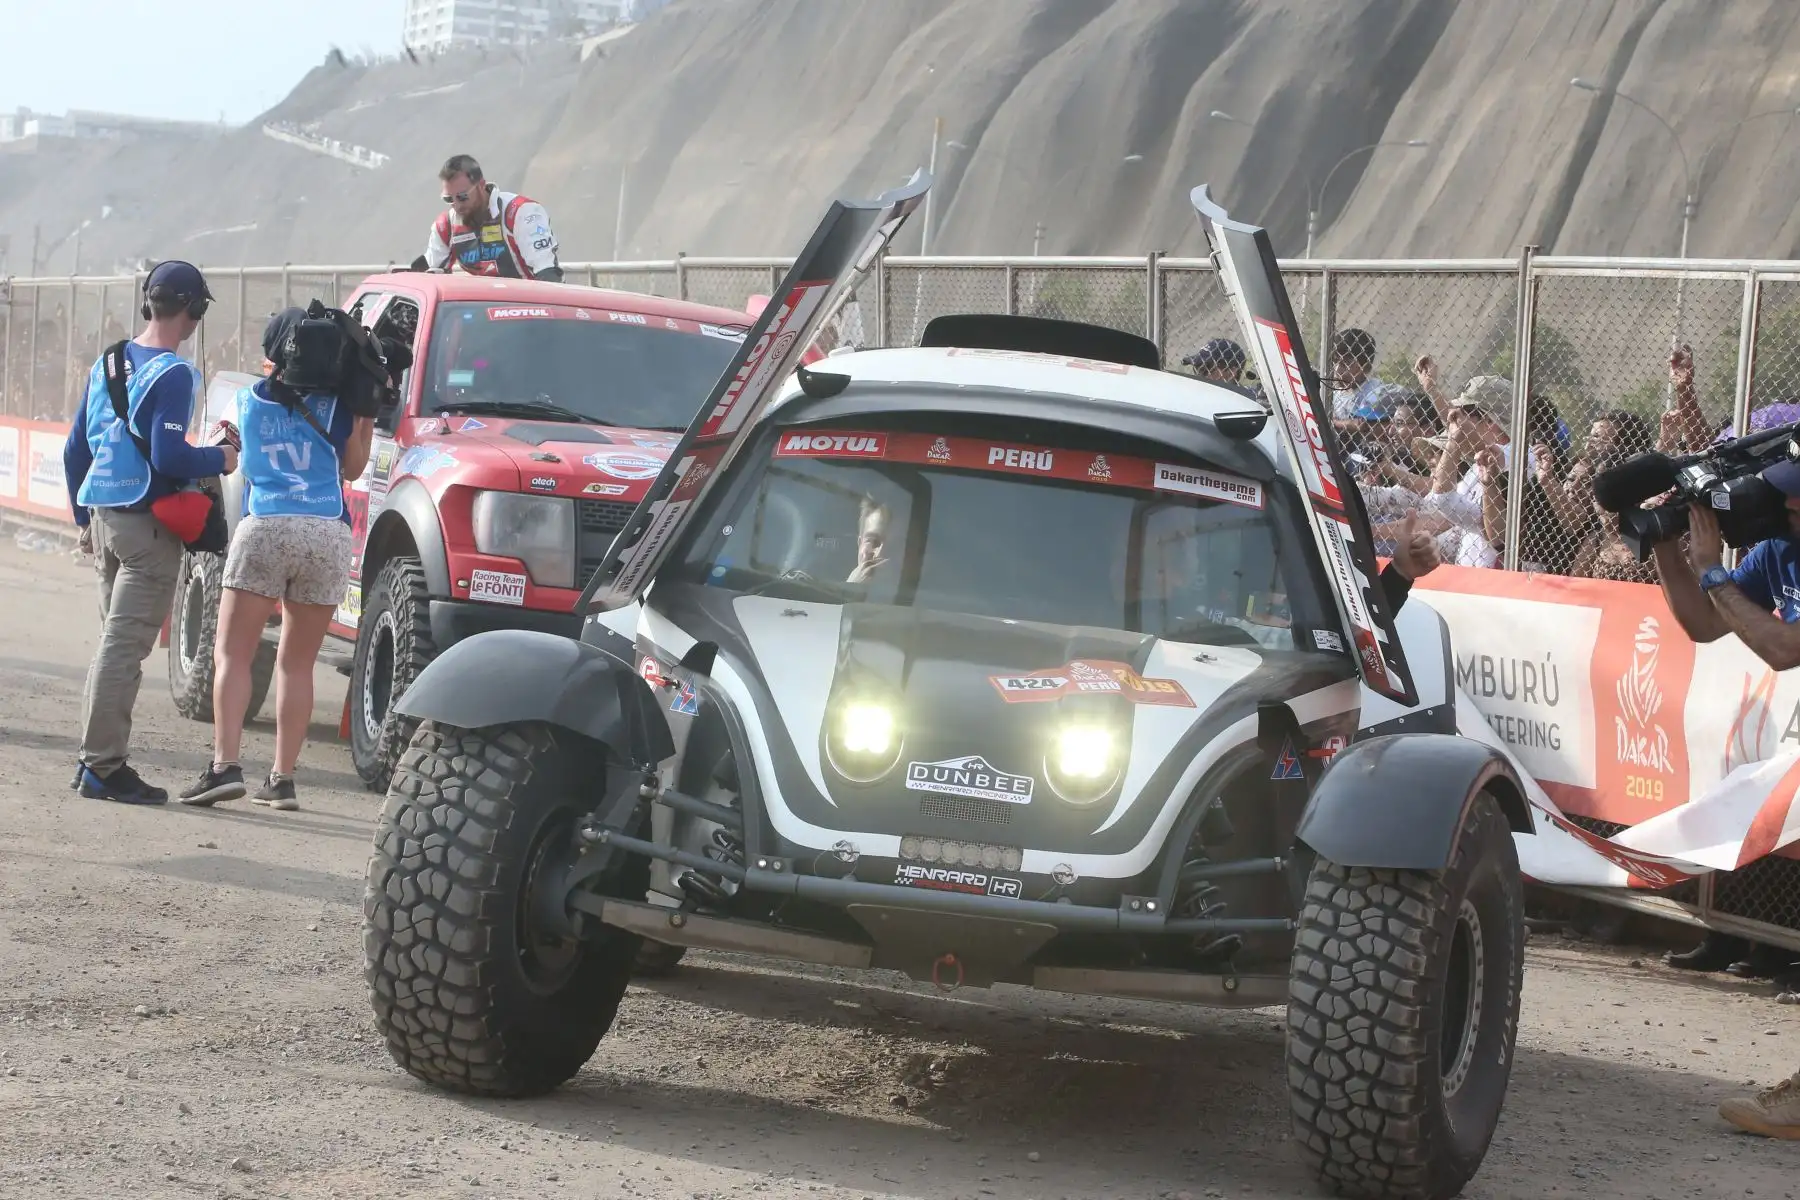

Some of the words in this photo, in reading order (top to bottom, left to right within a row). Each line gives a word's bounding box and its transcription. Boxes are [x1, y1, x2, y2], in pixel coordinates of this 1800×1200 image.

[494, 308, 549, 318] MOTUL
[608, 312, 647, 325] PERÚ
[784, 435, 879, 453] MOTUL
[89, 446, 114, 477] 2
[261, 441, 313, 471] TV
[988, 447, 1054, 471] PERÚ
[1160, 469, 1257, 496] Dakarthegame
[1233, 492, 1257, 503] .com
[473, 571, 500, 584] Racing
[503, 574, 524, 585] Team
[1324, 520, 1361, 622] Dakarthegame
[471, 580, 484, 592] Le
[1007, 678, 1061, 690] 424
[1111, 668, 1177, 693] 2019
[1615, 716, 1675, 774] DAKAR
[913, 766, 1029, 793] DUNBEE
[1625, 775, 1664, 802] 2019
[928, 784, 974, 795] HENRARD
[974, 789, 1009, 800] RACING
[895, 864, 988, 887] HENRARD
[993, 880, 1017, 895] HR
